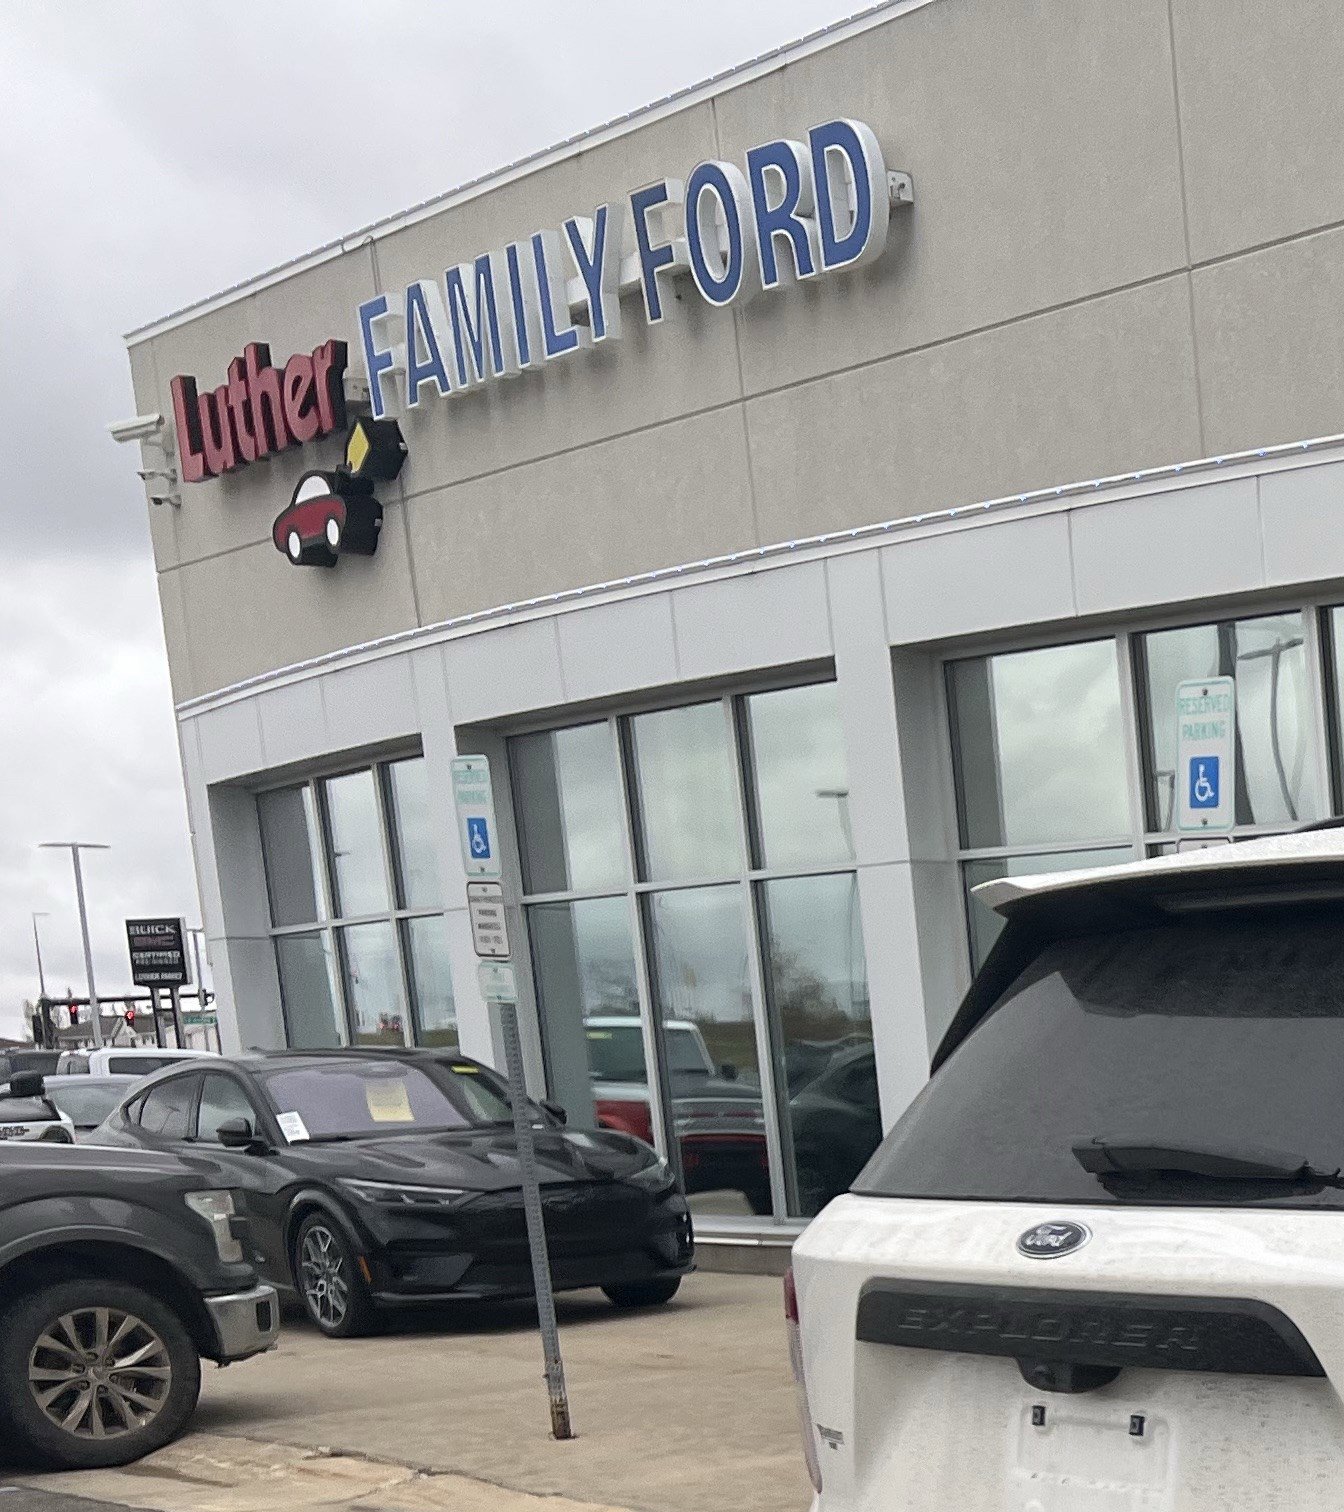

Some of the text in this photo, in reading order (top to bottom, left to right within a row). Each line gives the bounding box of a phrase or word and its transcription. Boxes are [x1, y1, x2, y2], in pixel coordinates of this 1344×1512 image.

[359, 117, 888, 421] FAMILY FORD
[170, 339, 347, 482] Luther
[1182, 720, 1226, 740] PARKING
[128, 924, 176, 935] BUICK
[898, 1307, 1201, 1350] EXPLORER
